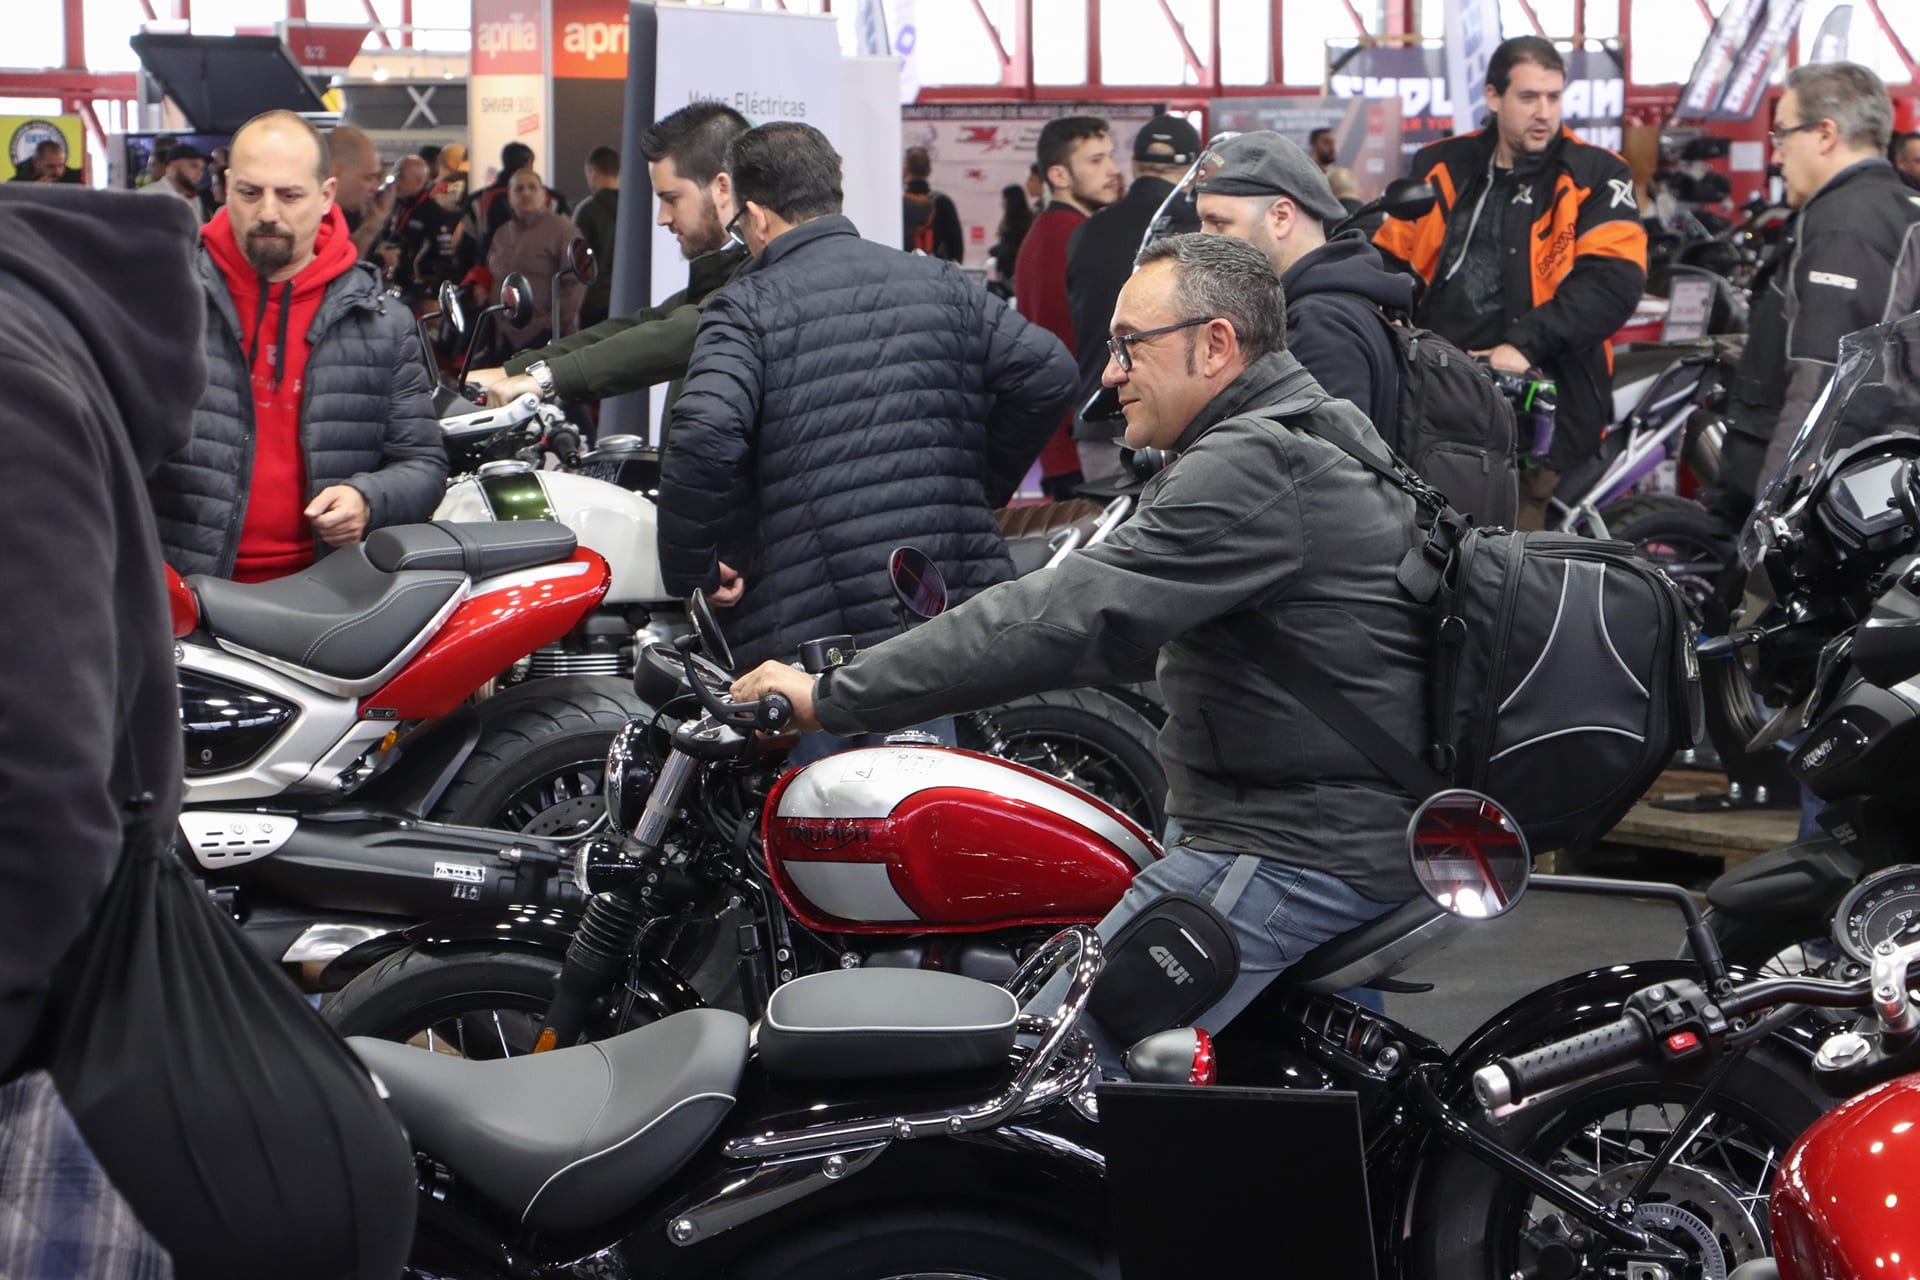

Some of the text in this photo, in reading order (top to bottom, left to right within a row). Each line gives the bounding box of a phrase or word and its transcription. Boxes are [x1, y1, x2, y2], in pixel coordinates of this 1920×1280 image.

[563, 14, 630, 61] apri
[734, 92, 807, 118] Eléctricas
[785, 825, 871, 846] TRIUMPH
[1148, 945, 1190, 986] GIVI
